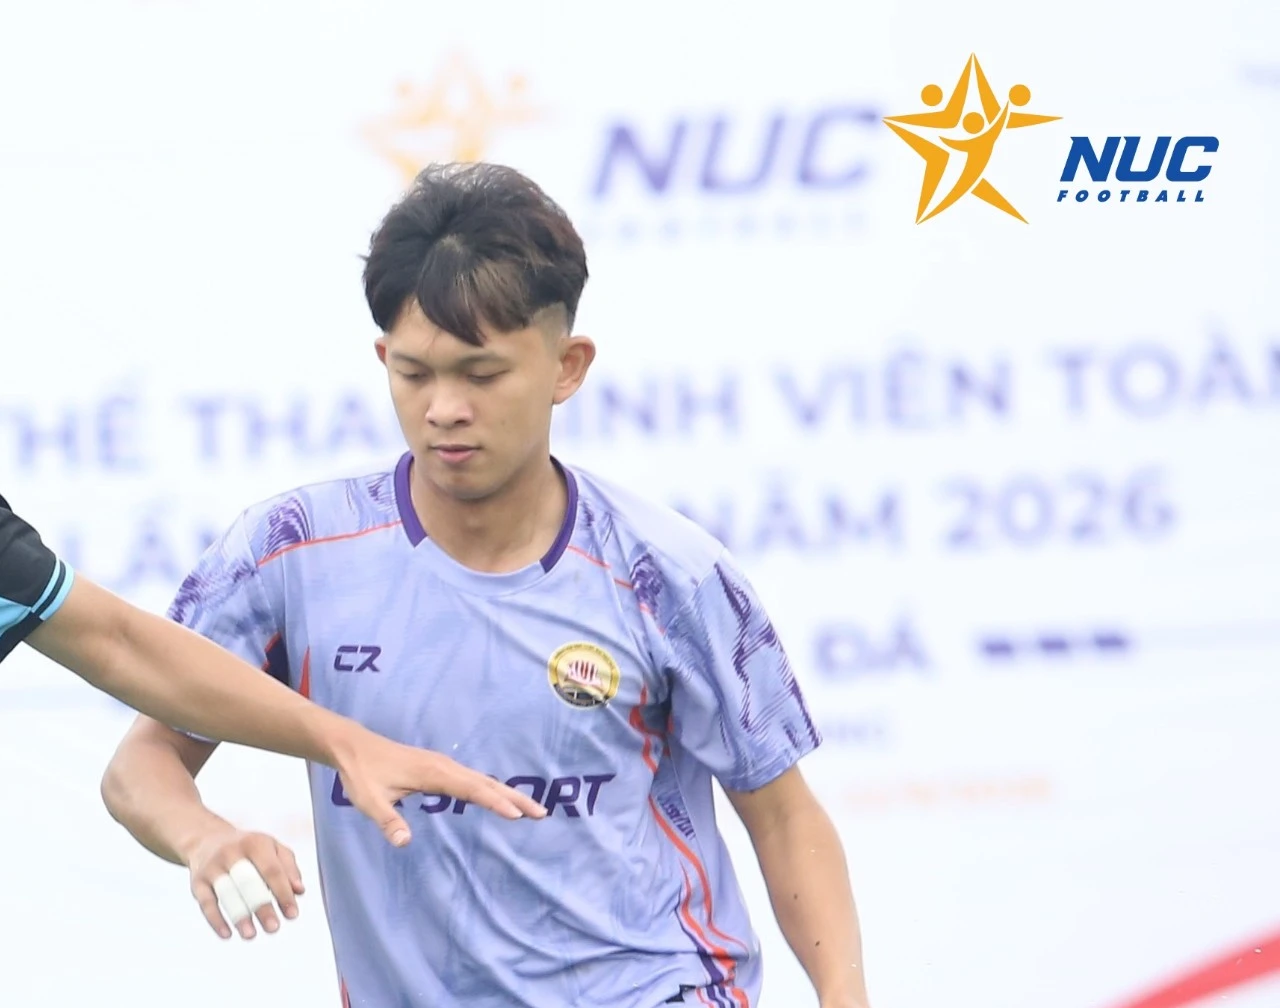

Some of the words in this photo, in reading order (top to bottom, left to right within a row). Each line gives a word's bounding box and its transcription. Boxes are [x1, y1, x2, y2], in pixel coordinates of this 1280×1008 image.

[588, 103, 884, 198] NUC
[188, 386, 400, 464] THA
[550, 366, 744, 442] INH
[937, 468, 1178, 551] 2026
